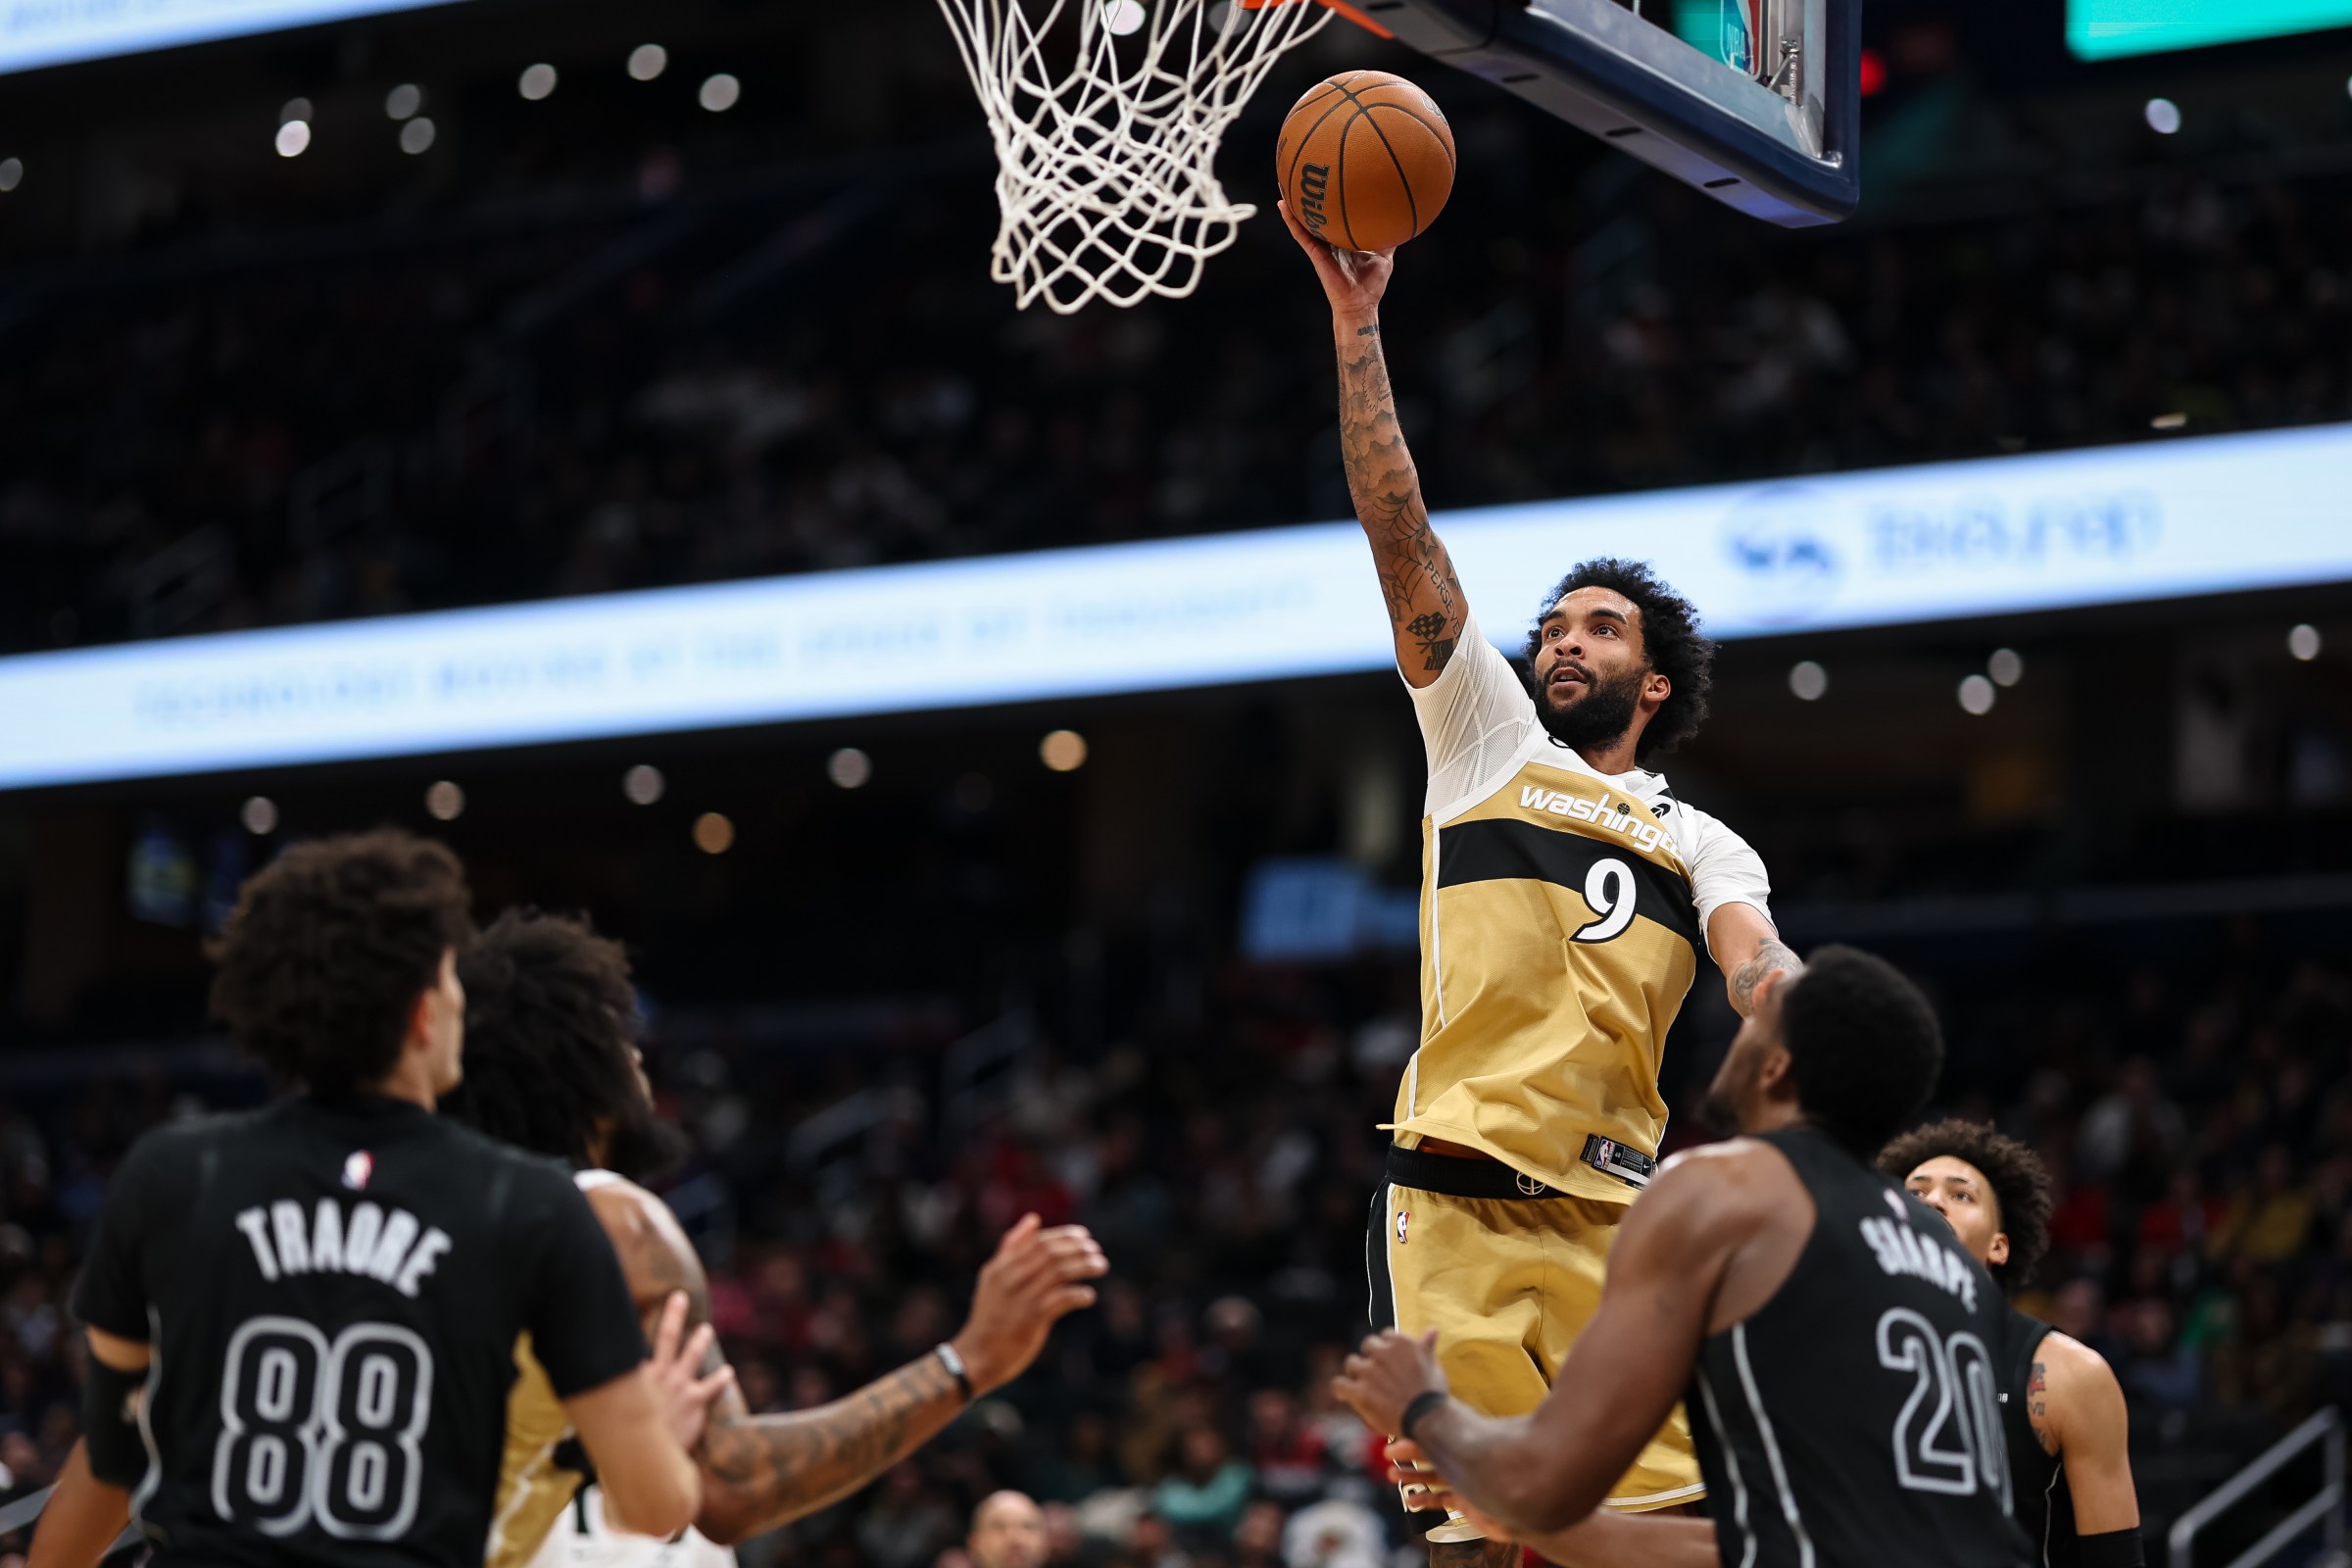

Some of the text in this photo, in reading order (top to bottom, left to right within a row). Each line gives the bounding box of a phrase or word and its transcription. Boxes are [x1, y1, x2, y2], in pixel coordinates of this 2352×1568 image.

[1424, 560, 1461, 639] PERSEVE
[1569, 858, 1637, 944] 9
[235, 1198, 453, 1298] TRAORE
[211, 1314, 434, 1542] 88
[1876, 1306, 2015, 1517] 20
